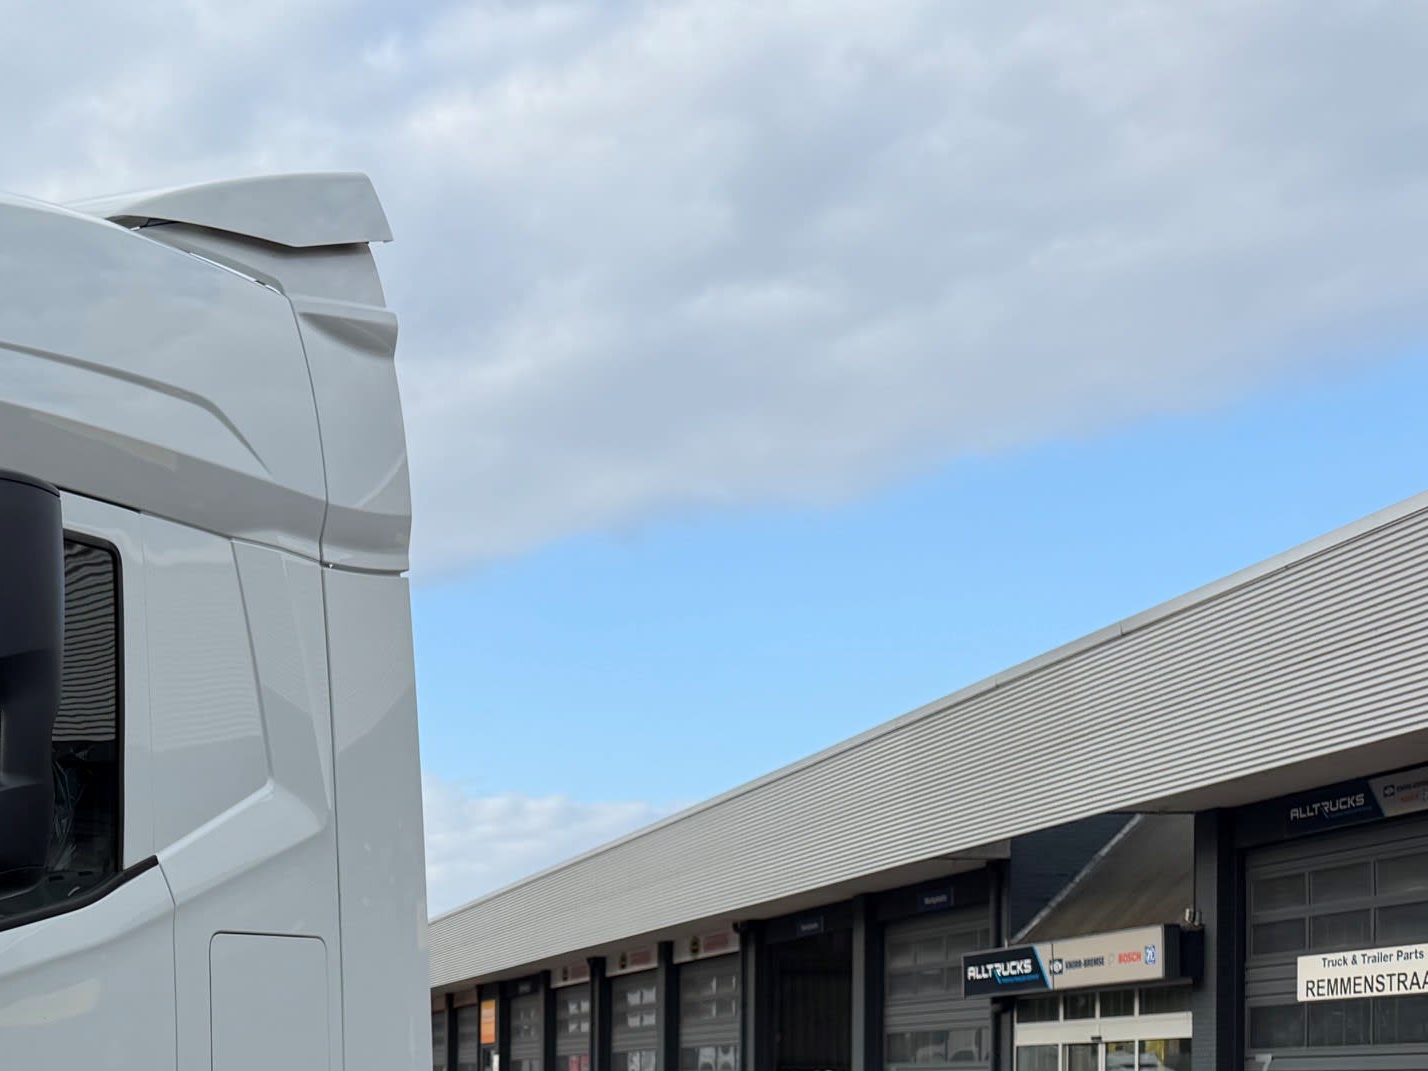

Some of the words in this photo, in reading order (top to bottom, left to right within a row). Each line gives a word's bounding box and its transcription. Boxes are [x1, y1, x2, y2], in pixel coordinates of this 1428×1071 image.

[1290, 793, 1365, 820] ALLTRUCKS
[1118, 951, 1142, 964] BOSCH
[1321, 955, 1349, 969] Truck
[1351, 954, 1358, 966] &
[1360, 950, 1394, 965] Trailer
[1396, 948, 1425, 961] Parts
[967, 959, 1032, 981] ALLTRUCKS
